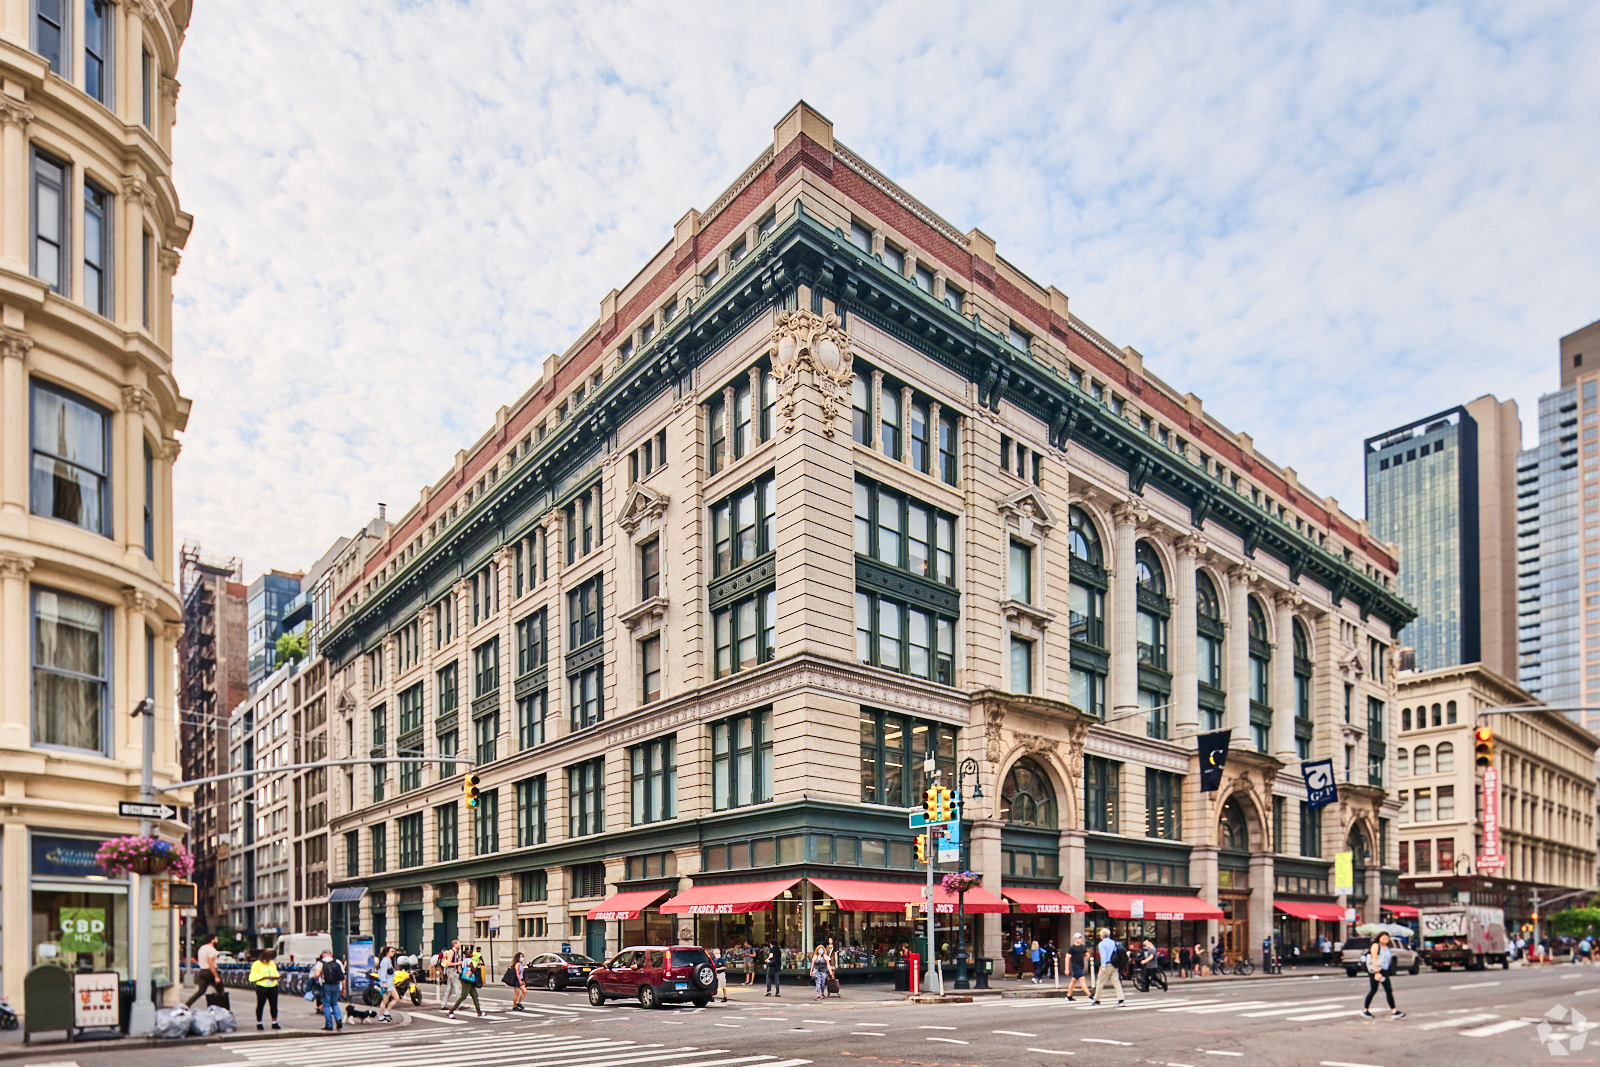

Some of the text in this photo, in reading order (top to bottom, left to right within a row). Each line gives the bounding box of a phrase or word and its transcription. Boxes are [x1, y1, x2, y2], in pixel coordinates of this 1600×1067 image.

[127, 805, 168, 816] ONE WAY
[1484, 771, 1496, 856] Burlington
[56, 846, 97, 859] Vitam
[687, 904, 733, 914] TRADER JOE'S
[935, 903, 954, 913] JOE'S
[1036, 904, 1076, 913] TRADER JOE'S
[595, 911, 630, 920] TRADER JOE'S
[61, 919, 104, 933] CBD
[74, 933, 91, 942] HQ
